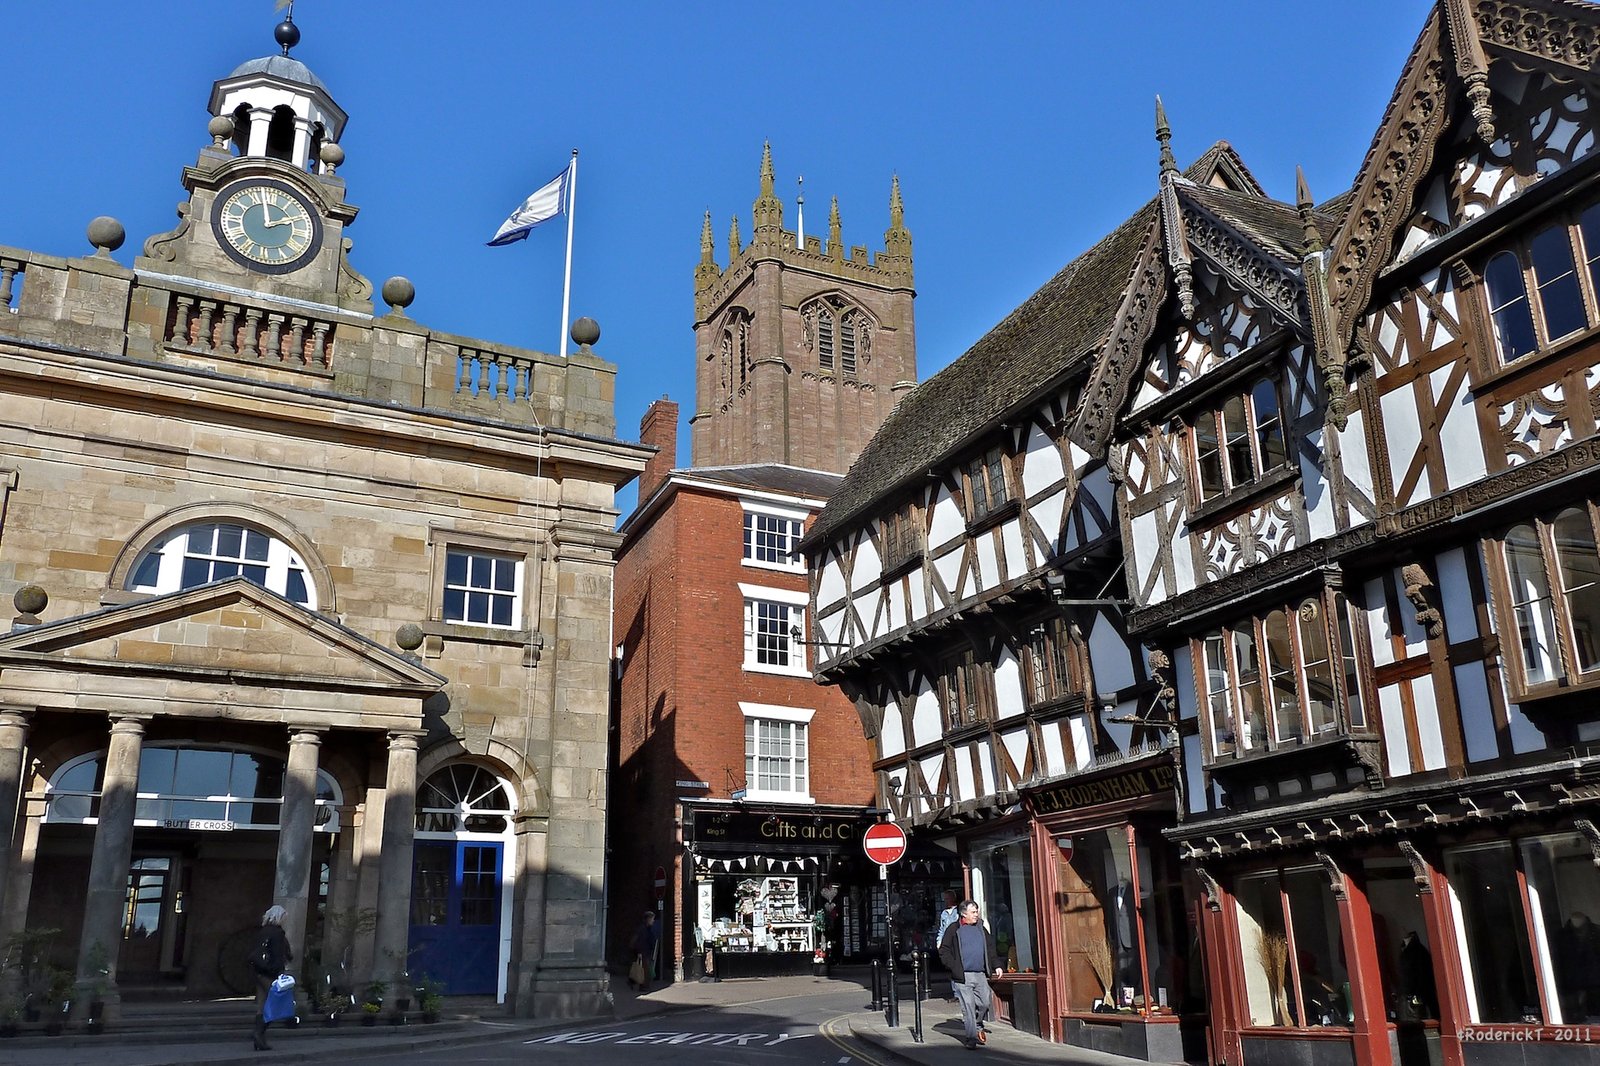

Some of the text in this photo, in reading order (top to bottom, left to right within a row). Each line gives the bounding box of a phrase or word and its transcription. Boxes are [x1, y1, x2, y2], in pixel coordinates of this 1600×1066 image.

[1063, 772, 1149, 808] BODENHAM
[166, 820, 232, 830] BUTTER CROSS
[761, 821, 797, 838] Gifts
[801, 823, 833, 839] and
[523, 1032, 816, 1046] NO ENTRY
